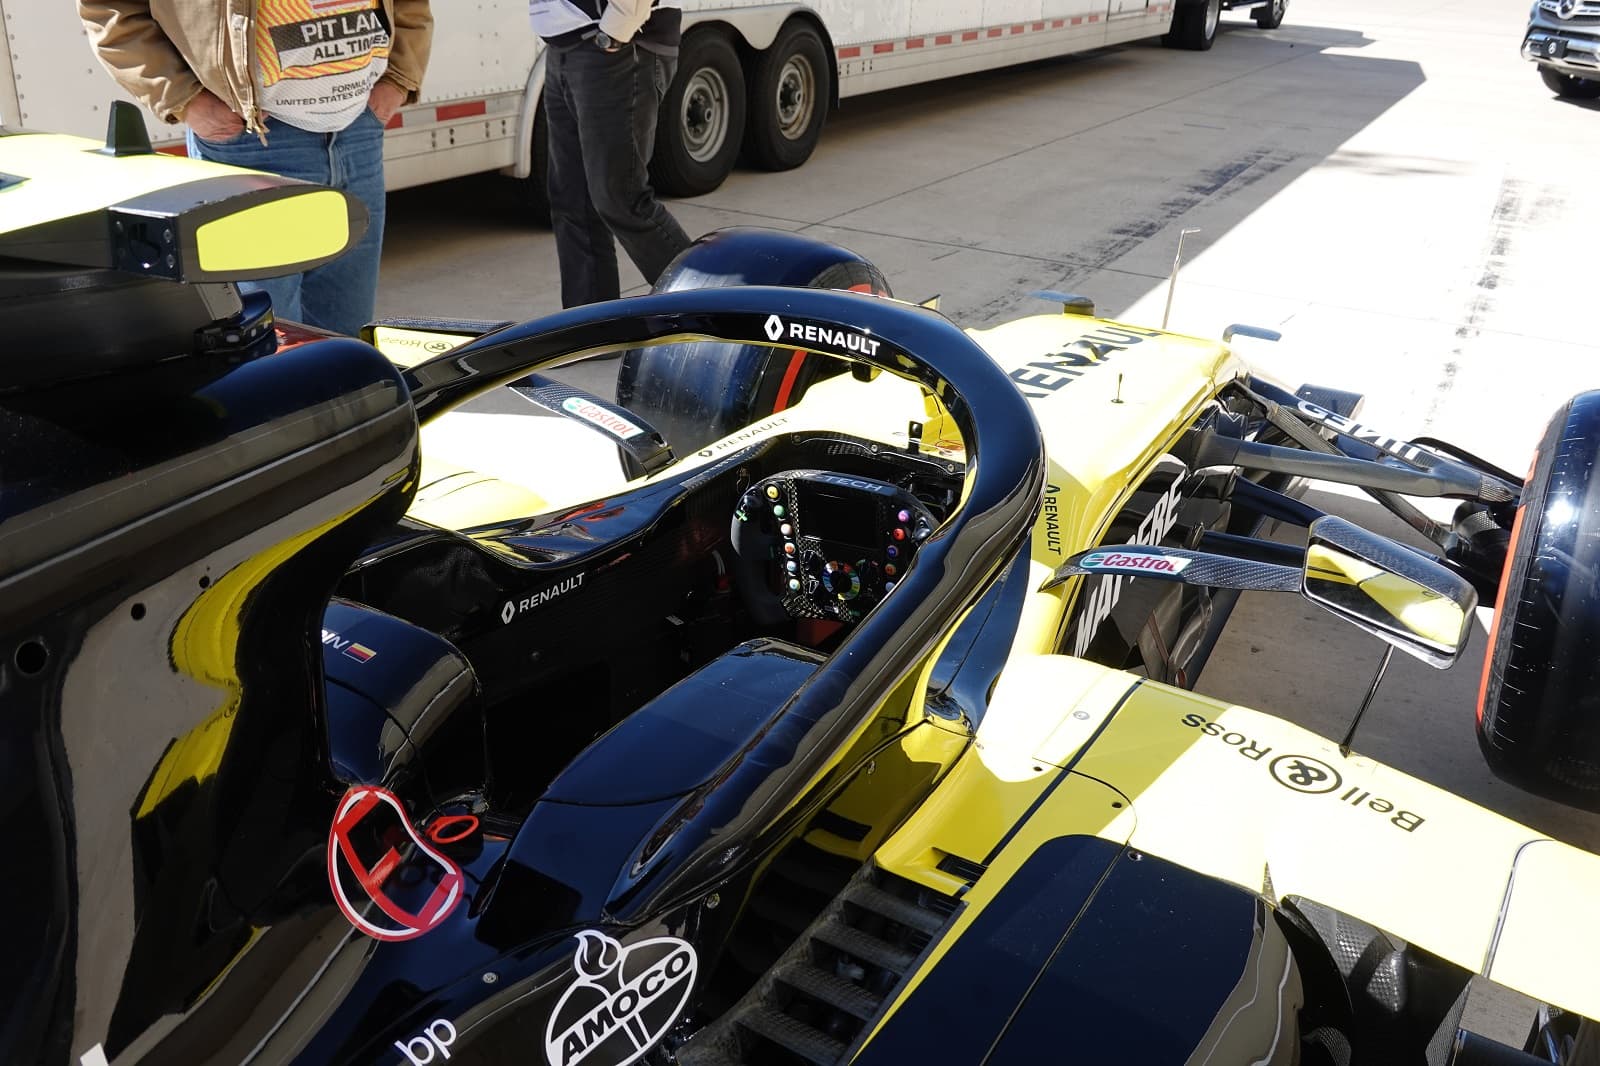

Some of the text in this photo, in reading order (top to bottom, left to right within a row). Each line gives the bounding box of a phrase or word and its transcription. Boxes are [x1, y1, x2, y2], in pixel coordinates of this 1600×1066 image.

[300, 11, 383, 43] PIT LAN
[313, 45, 345, 61] ALL
[276, 97, 317, 106] UNITED
[318, 91, 354, 104] STATES
[789, 322, 881, 356] RENAULT
[1009, 326, 1163, 399] ENAUL
[578, 404, 635, 435] Castrol
[716, 417, 789, 450] RENAULT
[1044, 496, 1062, 556] RENAULT
[1103, 553, 1176, 572] Castrol
[519, 572, 585, 613] RENAULT
[1180, 713, 1273, 761] Ross
[1340, 786, 1426, 833] Bell
[561, 950, 691, 1065] AMOCO
[394, 1017, 457, 1066] bp
